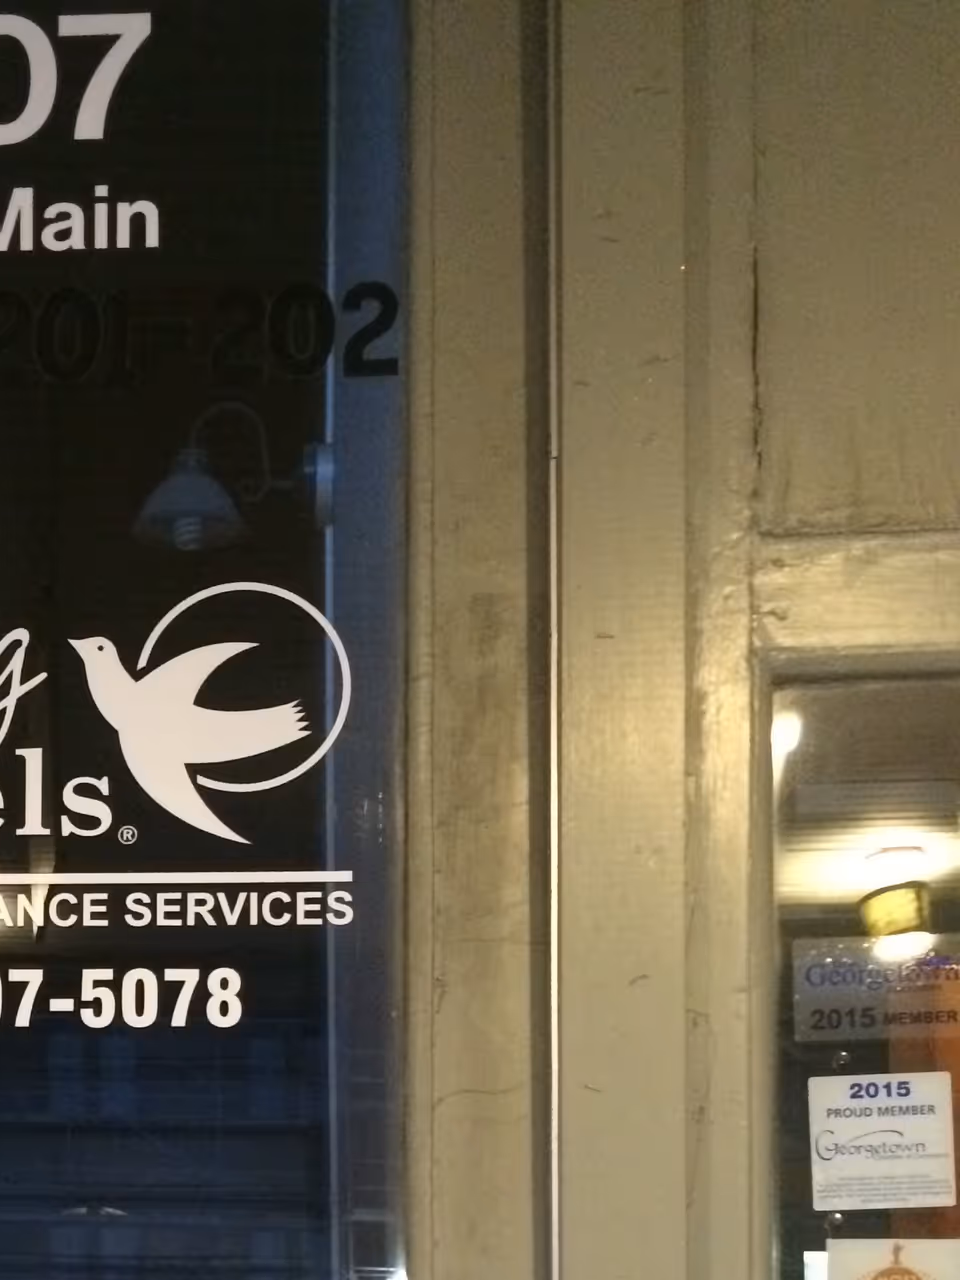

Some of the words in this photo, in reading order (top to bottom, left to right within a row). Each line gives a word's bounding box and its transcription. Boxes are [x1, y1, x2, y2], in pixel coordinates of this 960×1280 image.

[124, 890, 354, 927] SERVICES
[810, 1006, 876, 1030] 2015
[882, 1008, 959, 1026] MEMBER
[849, 1081, 911, 1099] 2015
[826, 1106, 873, 1119] PROUD
[877, 1104, 936, 1117] MEMBER
[815, 1129, 927, 1161] Georgetown
